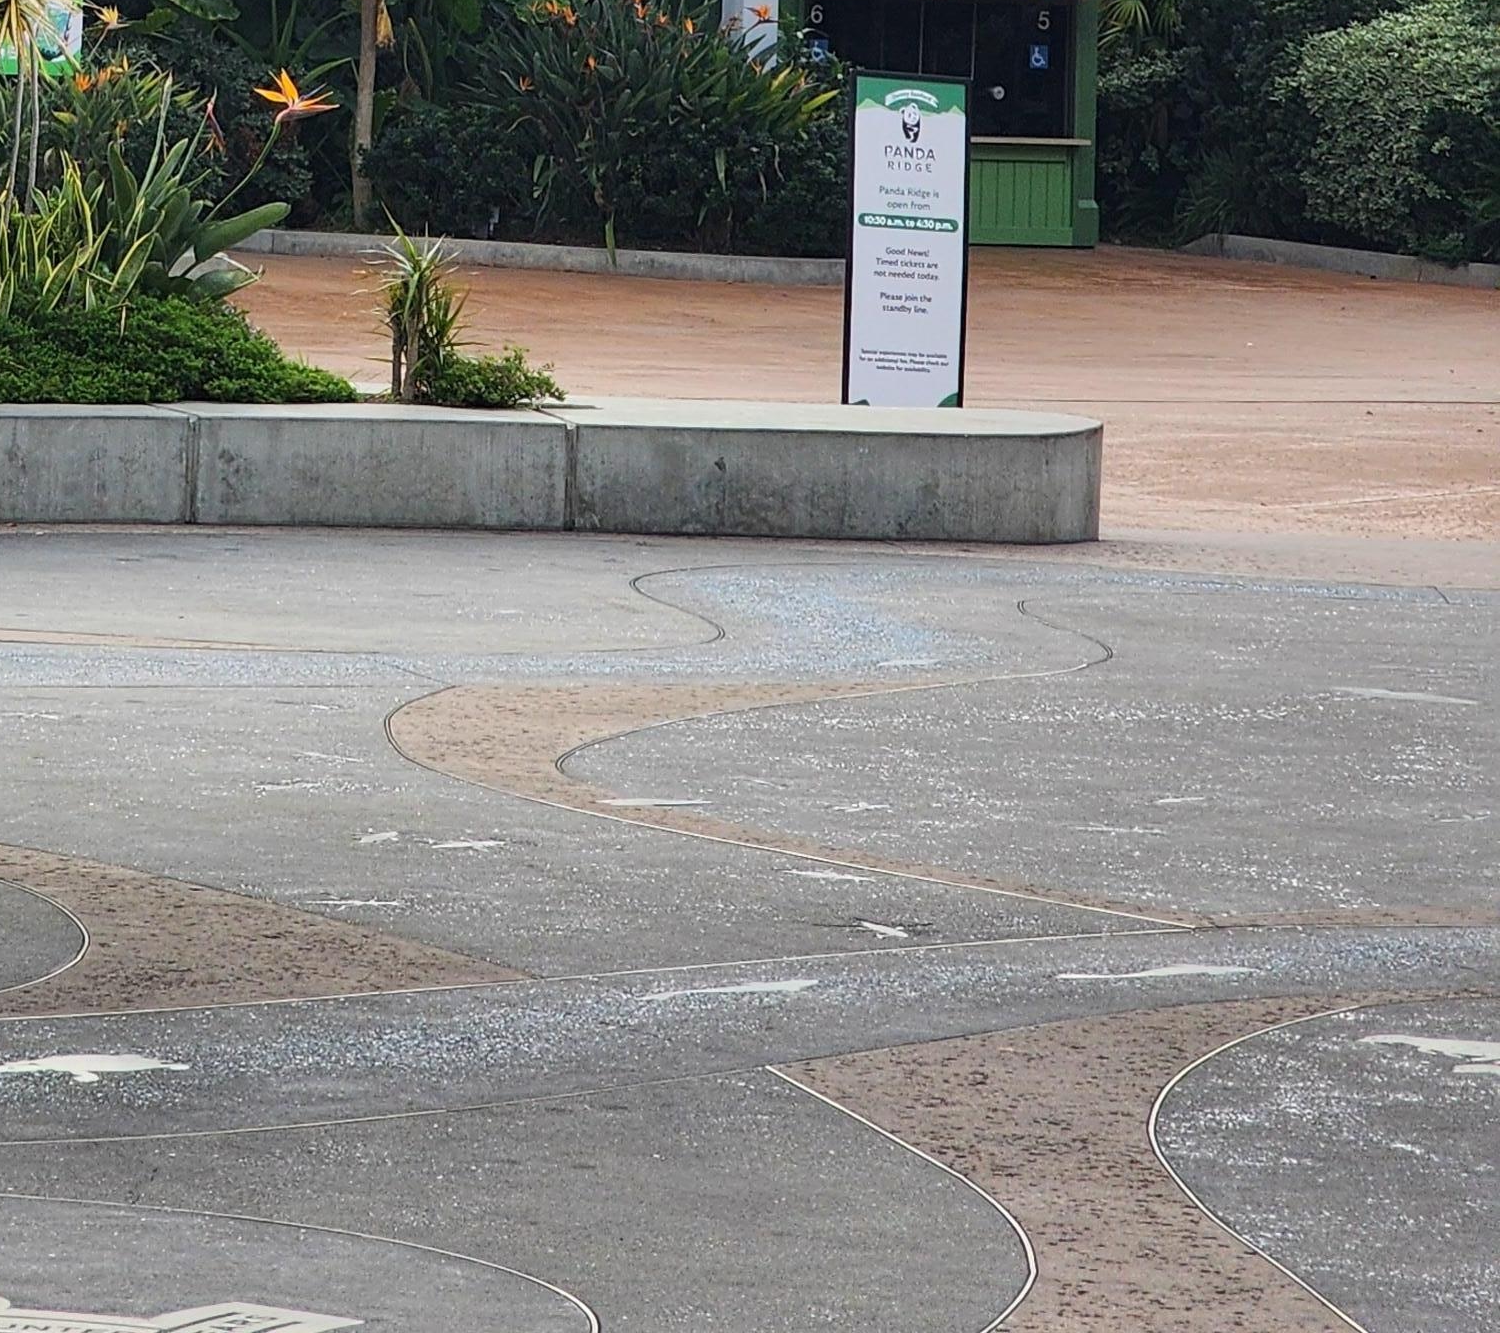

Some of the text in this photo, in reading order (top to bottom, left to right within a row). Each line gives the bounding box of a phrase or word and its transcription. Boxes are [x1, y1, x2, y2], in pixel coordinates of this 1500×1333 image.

[810, 4, 824, 24] 6
[1038, 11, 1050, 30] 5
[884, 145, 936, 161] PANDA
[887, 161, 932, 173] RIDGE
[879, 185, 940, 199] Panda Ridge is
[886, 201, 931, 210] open from
[863, 215, 886, 225] 10:30
[905, 219, 915, 228] to
[916, 219, 934, 229] 4:30
[935, 221, 953, 231] p.m.
[885, 247, 930, 257] Good News!
[876, 257, 899, 267] Timed
[900, 259, 925, 269] tickets
[888, 271, 915, 279] needed
[879, 292, 932, 303] Please join the
[882, 305, 912, 315] standby
